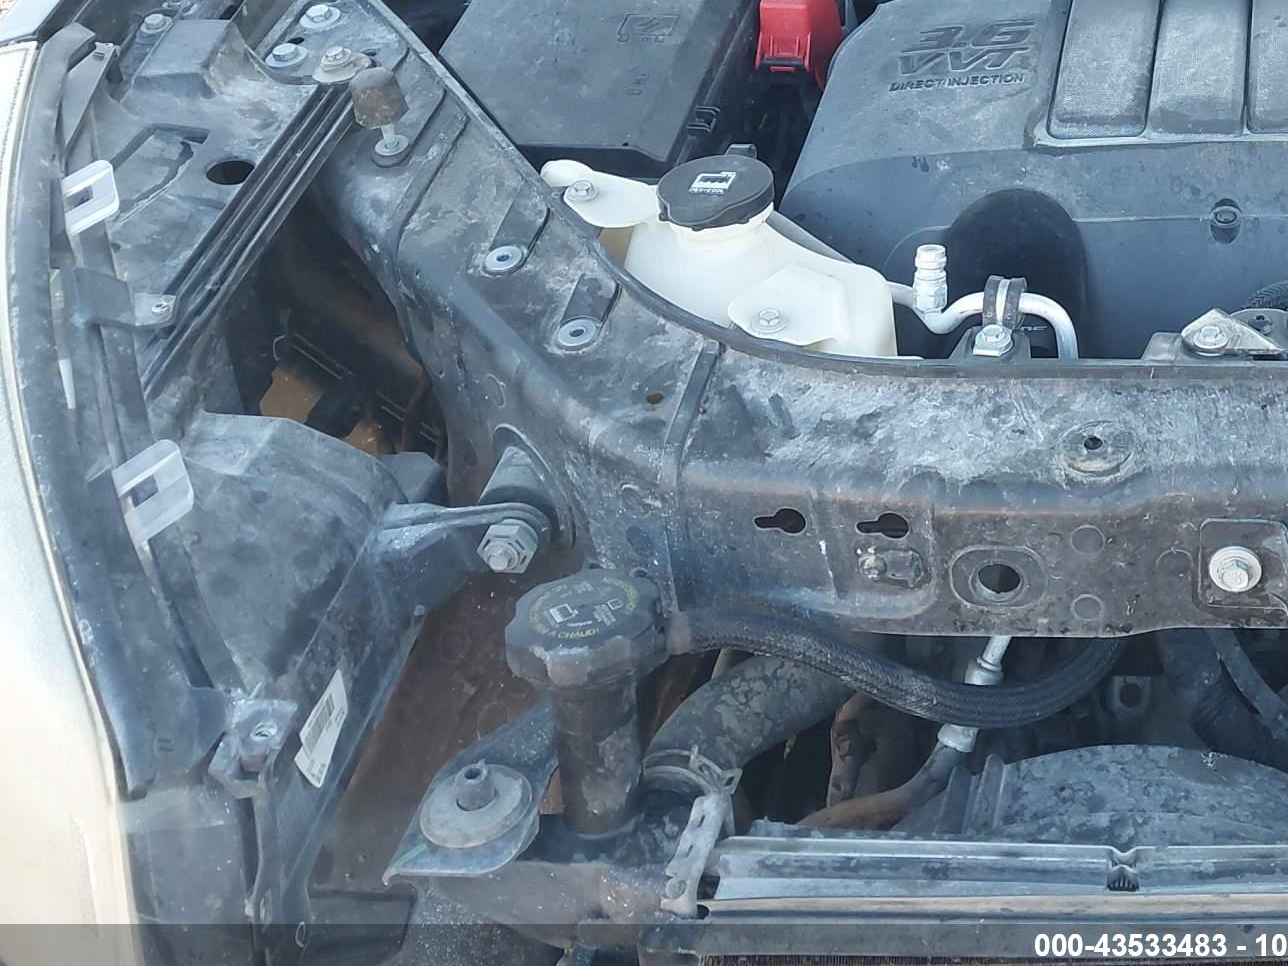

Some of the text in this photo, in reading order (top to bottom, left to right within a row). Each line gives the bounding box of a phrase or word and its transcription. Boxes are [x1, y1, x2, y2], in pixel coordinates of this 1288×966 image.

[901, 20, 1037, 53] 3.6
[899, 47, 1030, 74] VVT
[889, 73, 1025, 92] DIRECT INJECTION
